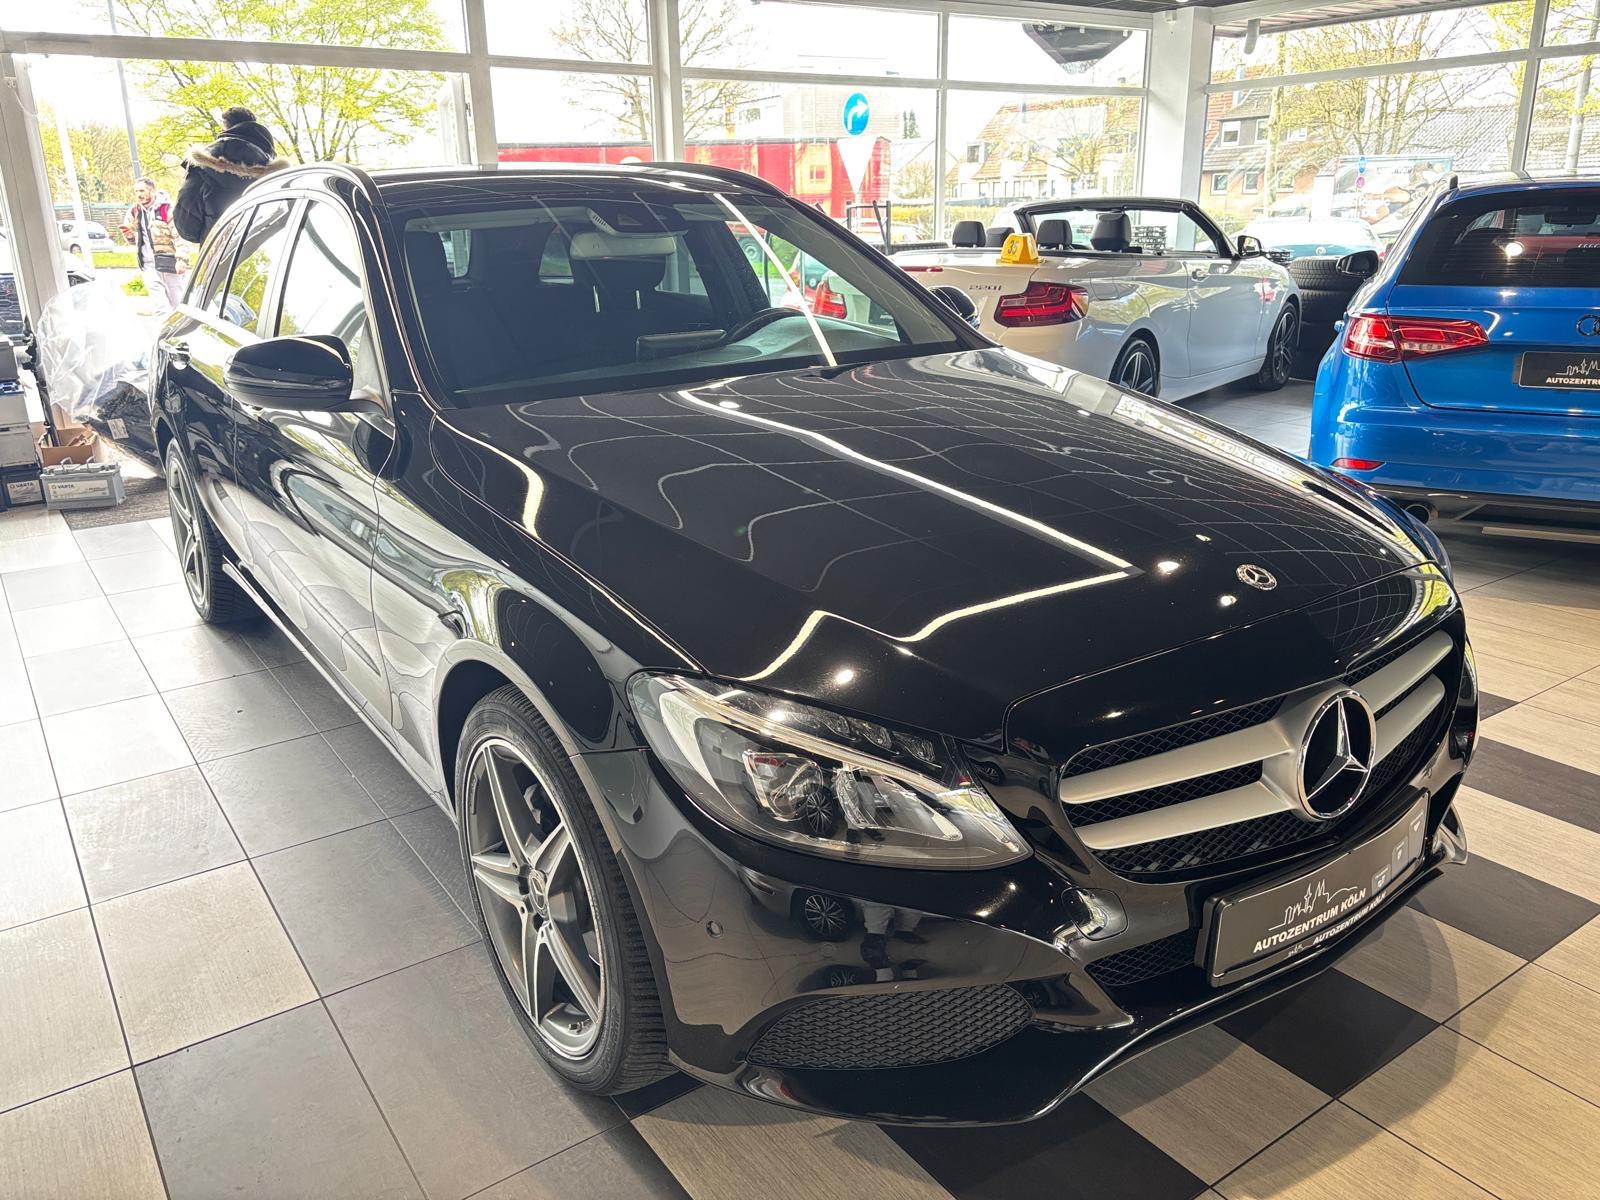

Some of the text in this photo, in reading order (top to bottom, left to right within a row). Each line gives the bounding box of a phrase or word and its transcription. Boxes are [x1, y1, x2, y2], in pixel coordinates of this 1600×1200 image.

[1253, 887, 1367, 953] AUTOZENTRUM KÖLN
[1312, 890, 1387, 946] AUTOZENTRUM KÖLN
